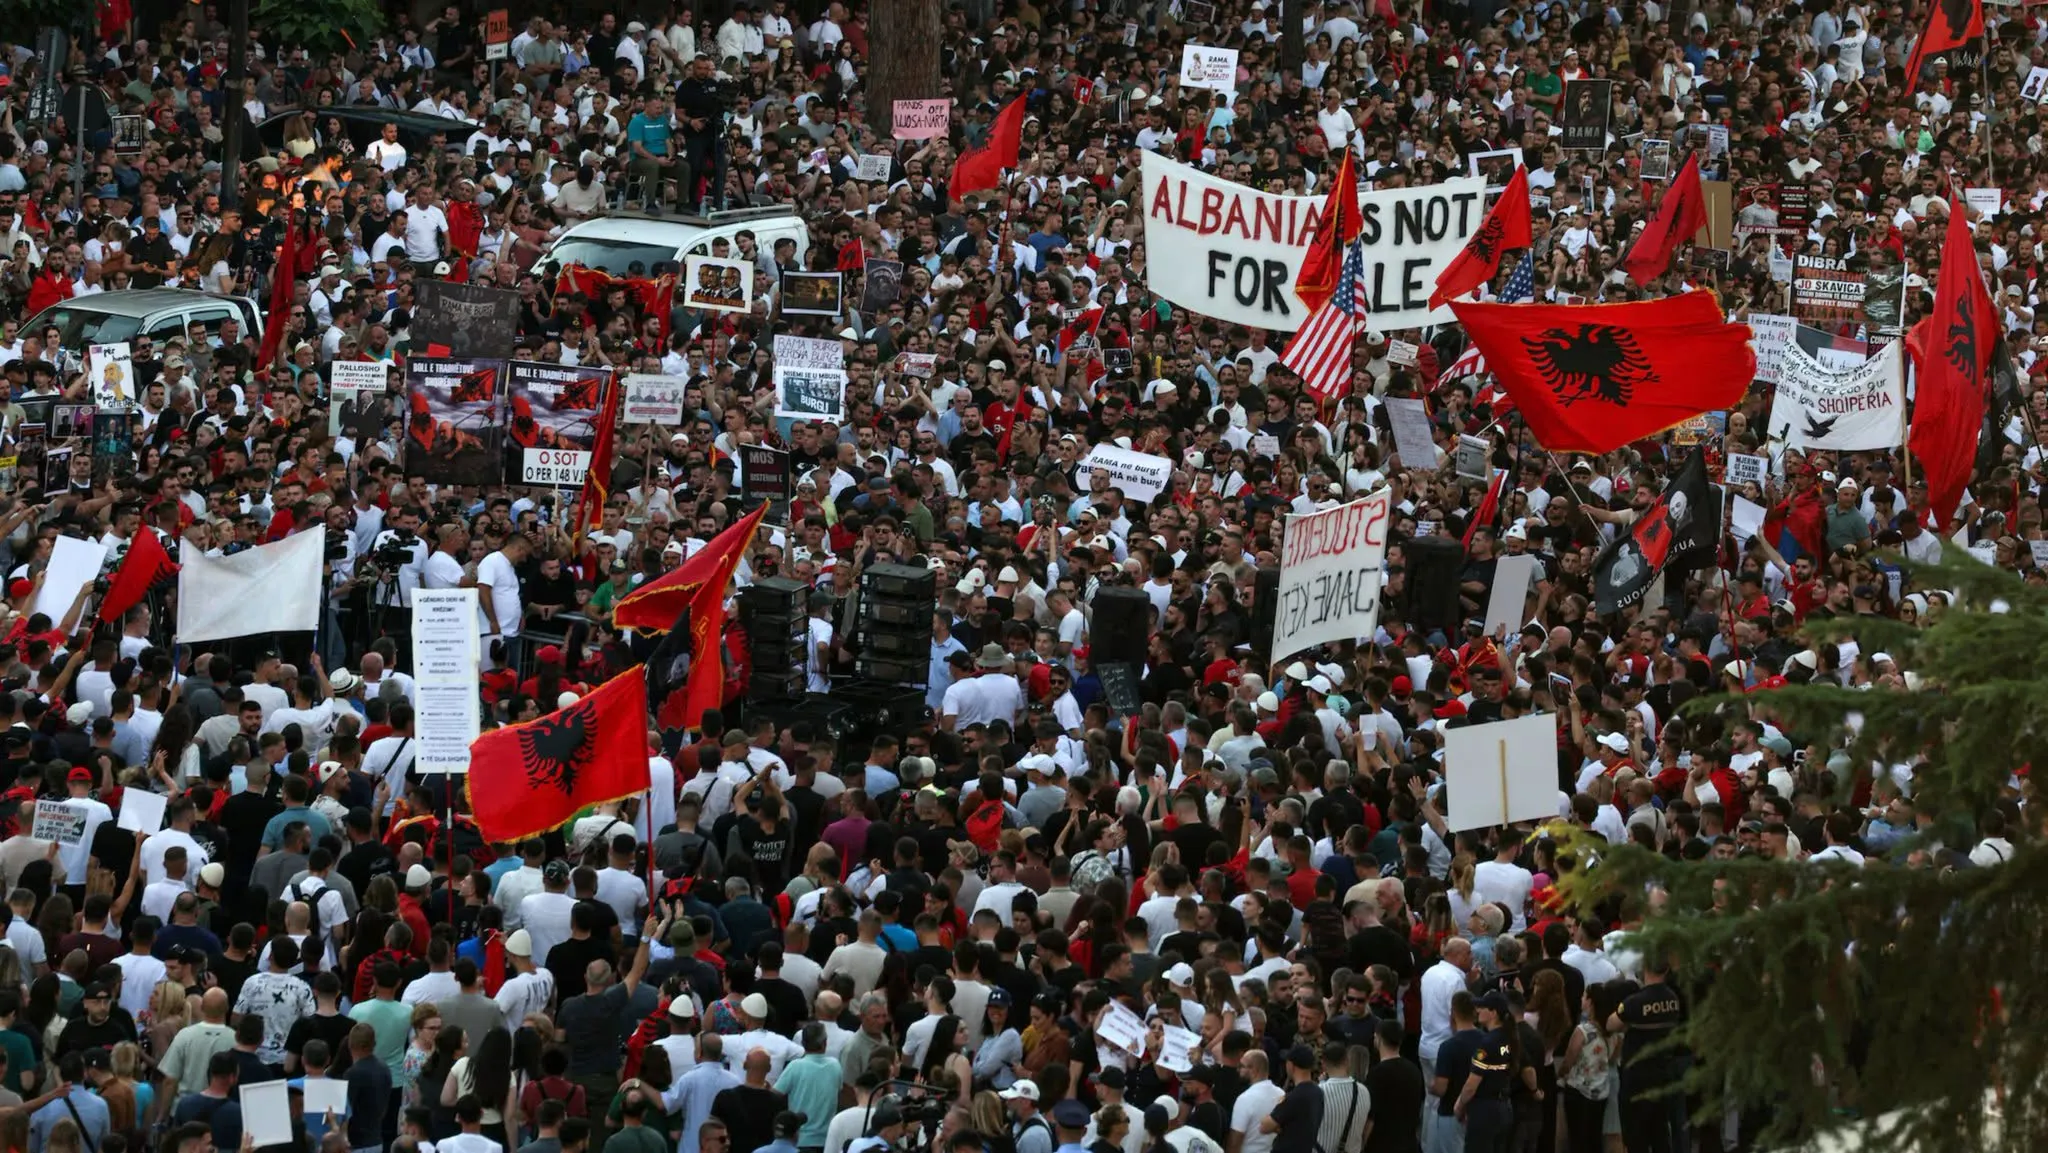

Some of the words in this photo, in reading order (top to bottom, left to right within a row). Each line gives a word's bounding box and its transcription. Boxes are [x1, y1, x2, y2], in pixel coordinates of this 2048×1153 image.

[490, 21, 506, 32] TAXI
[897, 101, 924, 110] HANDS
[928, 105, 944, 114] OFF
[1568, 126, 1600, 138] RAMA
[1151, 174, 1319, 248] ALBANIA
[1361, 203, 1382, 246] S
[1394, 192, 1478, 246] NOT
[1798, 254, 1847, 271] DIBRA
[1208, 249, 1291, 316] FOR
[1798, 280, 1812, 289] JO
[1815, 281, 1861, 293] SKAVICA
[777, 337, 806, 349] RAMA
[339, 364, 381, 372] PALLOSHO
[413, 362, 428, 373] BOLL
[516, 367, 532, 378] BOLL
[800, 394, 829, 414] BURGU
[1817, 392, 1893, 414] SHQIPËRIA
[539, 450, 550, 465] O
[554, 451, 579, 466] SOT
[749, 451, 775, 465] MOS
[1090, 456, 1118, 467] RAMA
[1120, 462, 1133, 470] në
[1135, 463, 1161, 477] burg!
[526, 466, 534, 480] O
[536, 467, 552, 481] PER
[555, 468, 571, 482] 148
[1080, 464, 1124, 480] BEHA
[1126, 474, 1138, 483] në
[1140, 476, 1163, 489] burg!
[39, 802, 57, 812] FLET
